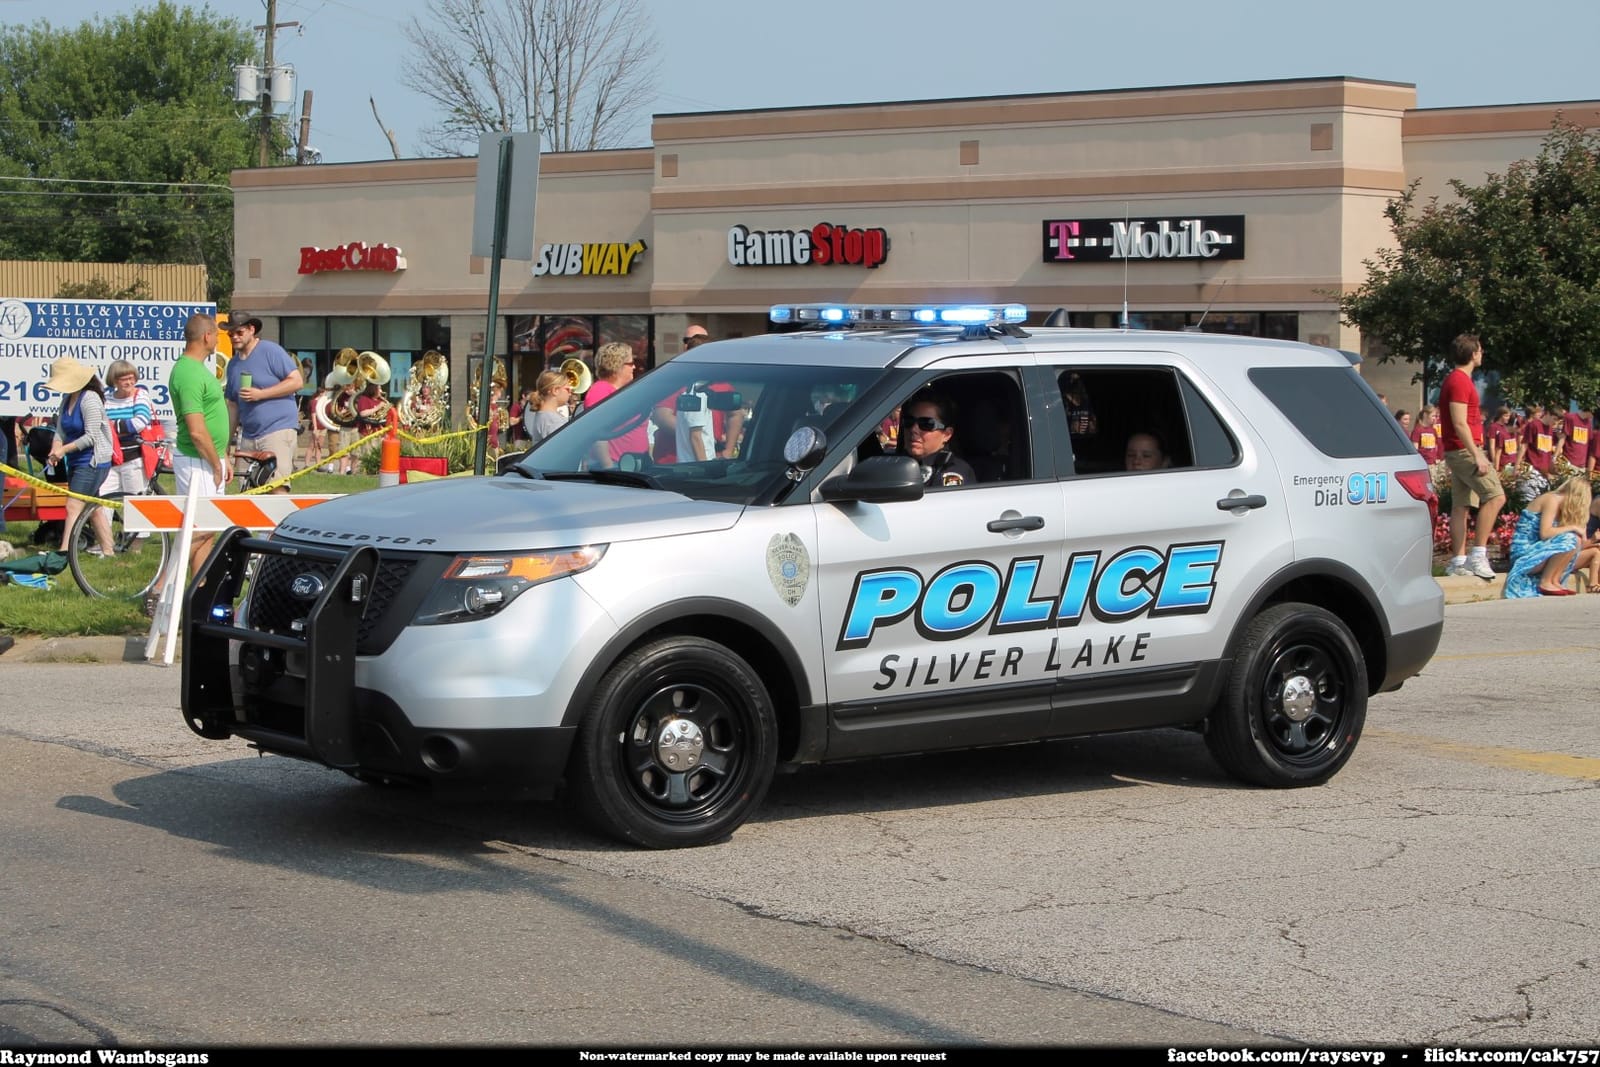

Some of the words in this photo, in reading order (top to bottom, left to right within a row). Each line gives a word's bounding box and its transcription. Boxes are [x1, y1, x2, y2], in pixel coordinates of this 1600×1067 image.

[532, 240, 646, 275] SUBWAY
[727, 223, 885, 268] GameStop
[46, 327, 119, 338] COMMERCIAL
[125, 329, 153, 339] REAL
[159, 330, 186, 340] ESTA
[0, 343, 107, 360] EDEVELOPMENT
[111, 345, 186, 361] OPPORTU
[1293, 474, 1345, 487] Emergency
[1314, 488, 1344, 507] Dial
[1347, 471, 1389, 505] 911
[291, 577, 312, 594] Ford
[835, 539, 1226, 652] POLICE
[872, 645, 1024, 691] SILVER
[1044, 632, 1152, 673] LAKE
